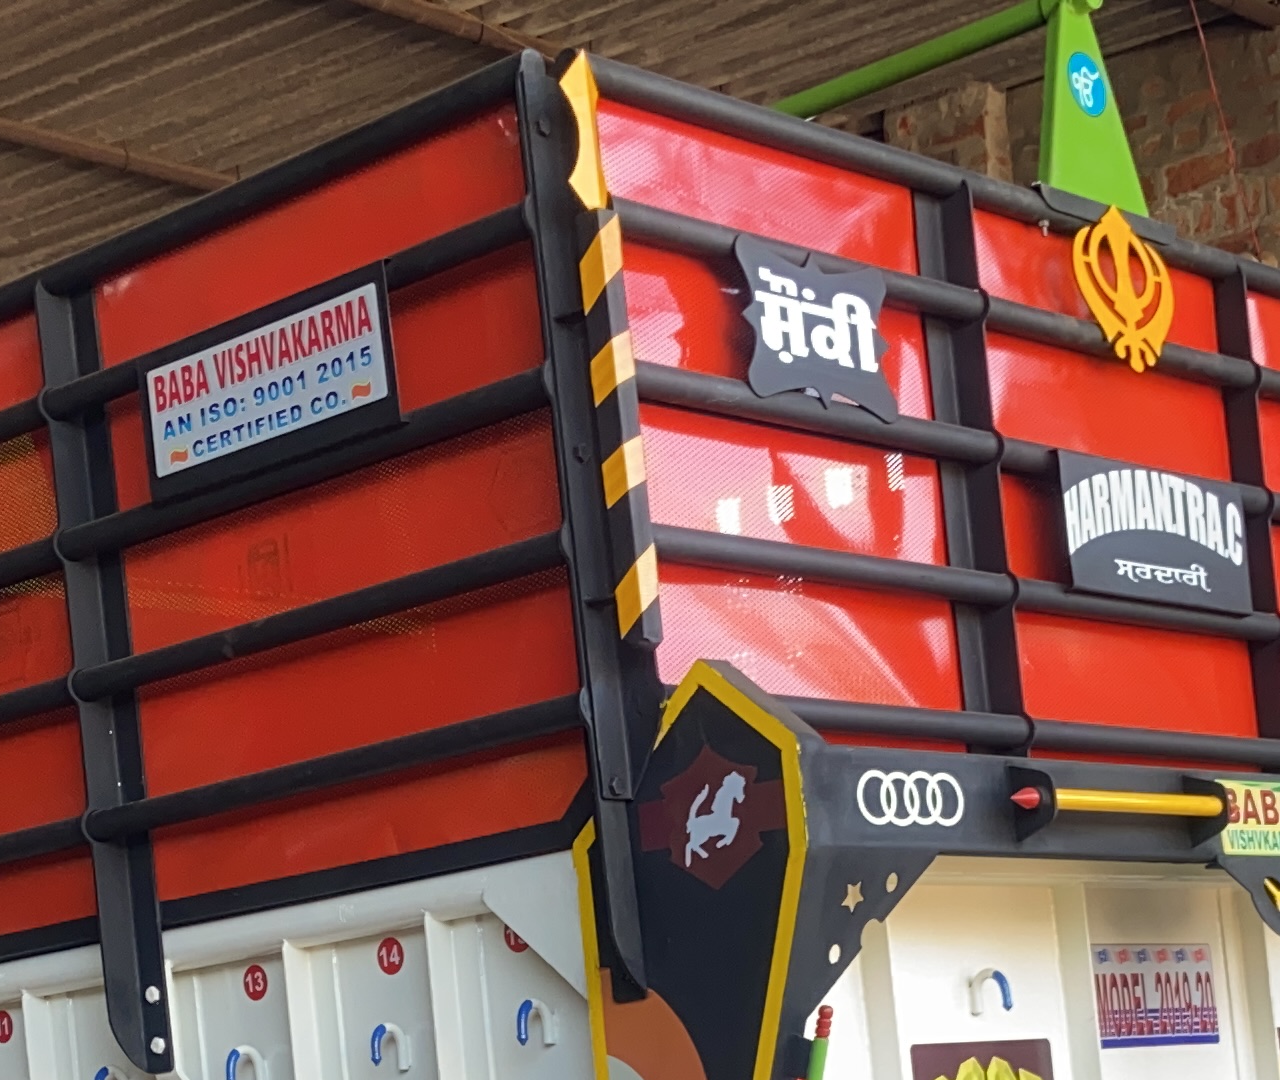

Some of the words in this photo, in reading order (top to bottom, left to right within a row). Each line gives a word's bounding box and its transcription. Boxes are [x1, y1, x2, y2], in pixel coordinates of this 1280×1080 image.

[153, 359, 210, 413] BABA
[212, 295, 373, 390] VISHVAKARMA
[163, 413, 192, 441] AN
[200, 397, 247, 427] ISO:
[252, 371, 307, 407] 9001
[315, 345, 372, 384] 2015
[192, 404, 303, 457] CERTIFIED
[310, 391, 347, 416] CO.
[245, 974, 265, 994] 13
[379, 944, 402, 966] 14
[1094, 972, 1154, 1038] MODEL
